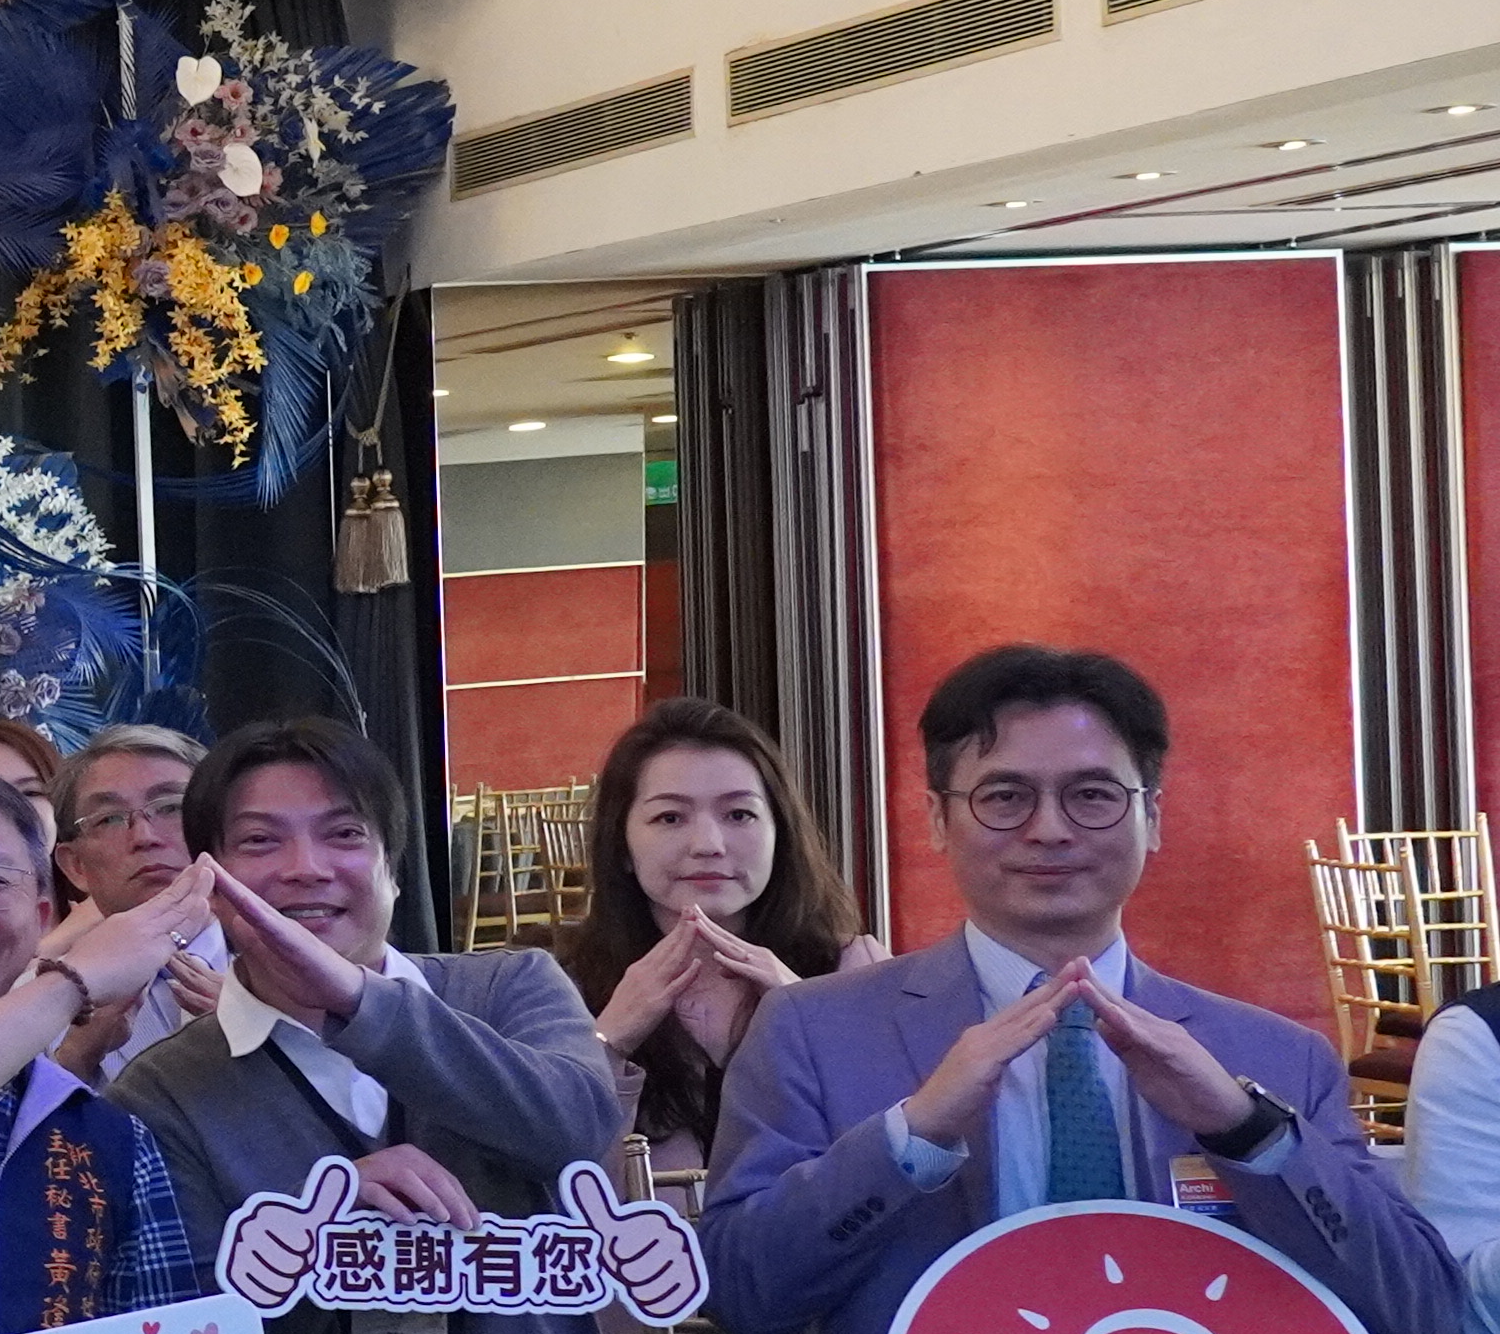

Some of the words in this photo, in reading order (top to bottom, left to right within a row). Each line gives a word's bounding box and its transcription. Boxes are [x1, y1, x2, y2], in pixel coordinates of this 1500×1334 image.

[1179, 1183, 1215, 1193] Archi
[324, 1229, 595, 1296] 感謝有您
